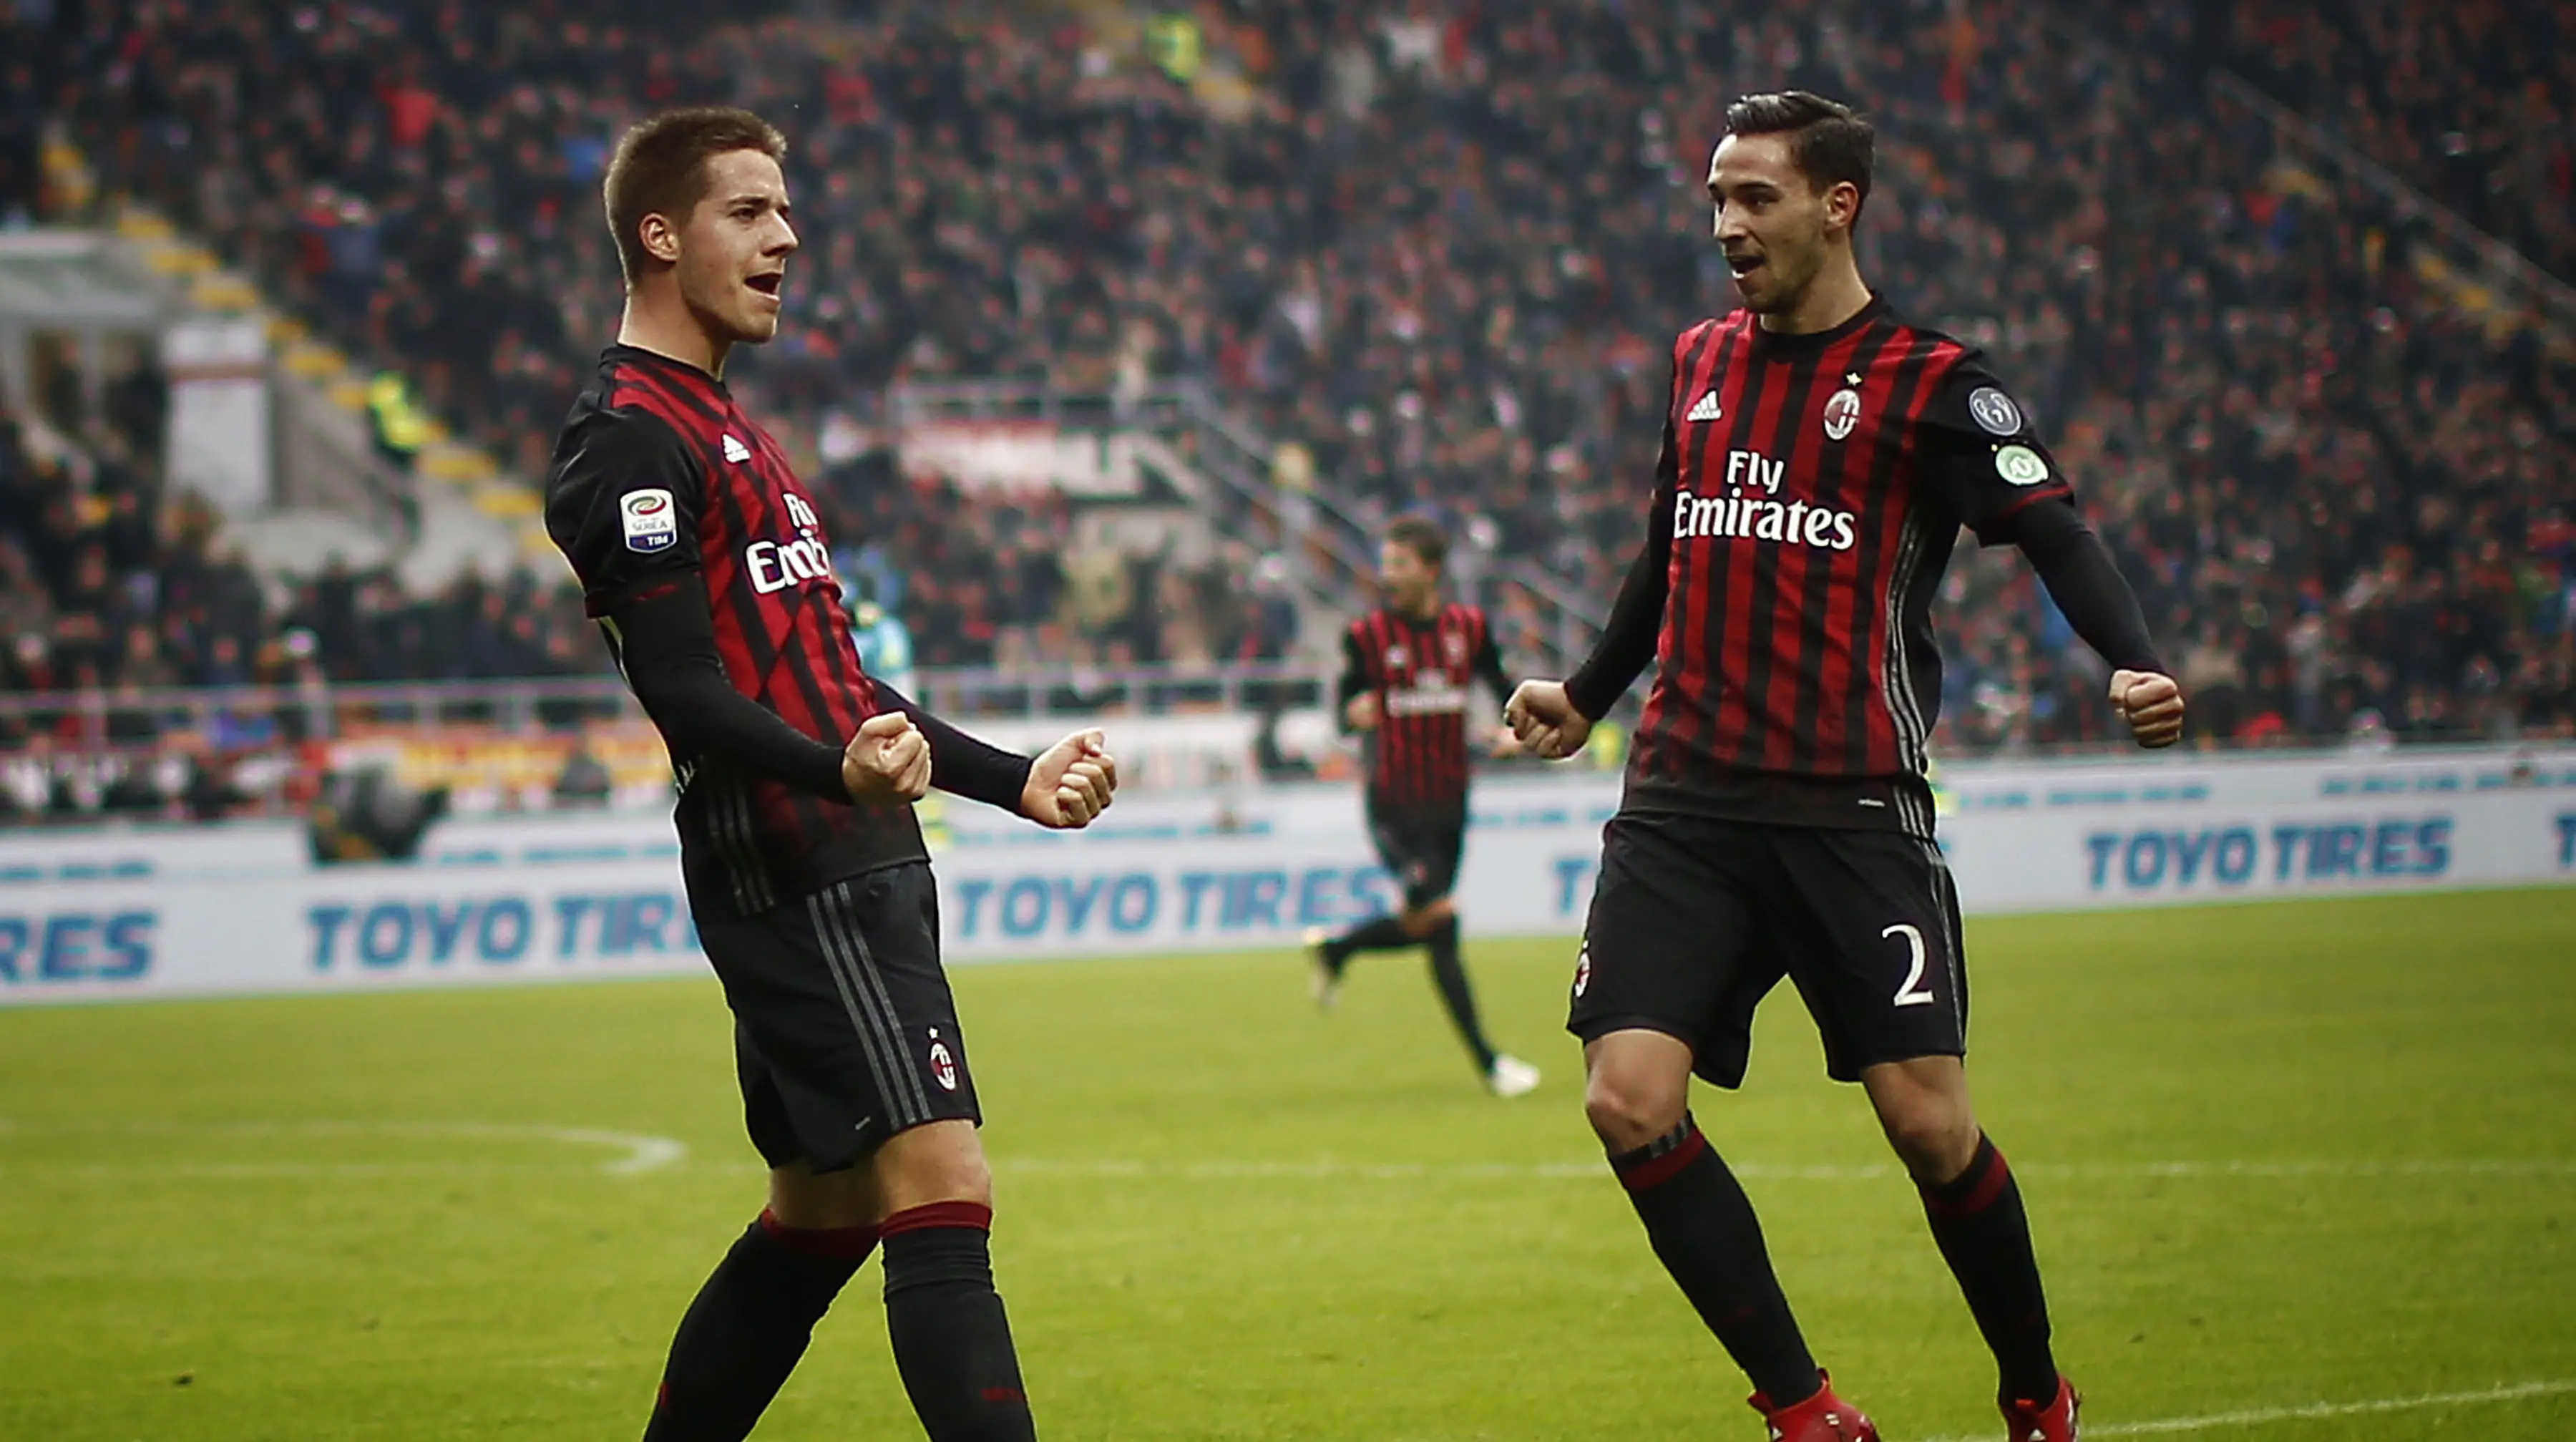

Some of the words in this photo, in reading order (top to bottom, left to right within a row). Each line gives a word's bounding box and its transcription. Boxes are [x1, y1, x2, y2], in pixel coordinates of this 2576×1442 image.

[1727, 450, 1785, 495] Fly
[647, 534, 668, 546] TIM
[1674, 487, 1855, 550] Emirates
[2085, 827, 2258, 890] TOYO
[2271, 816, 2454, 881] TIRES
[309, 897, 531, 970] TOYO
[956, 872, 1160, 939] TOYO
[1177, 866, 1390, 932] TIRES
[1882, 924, 1934, 1006] 2
